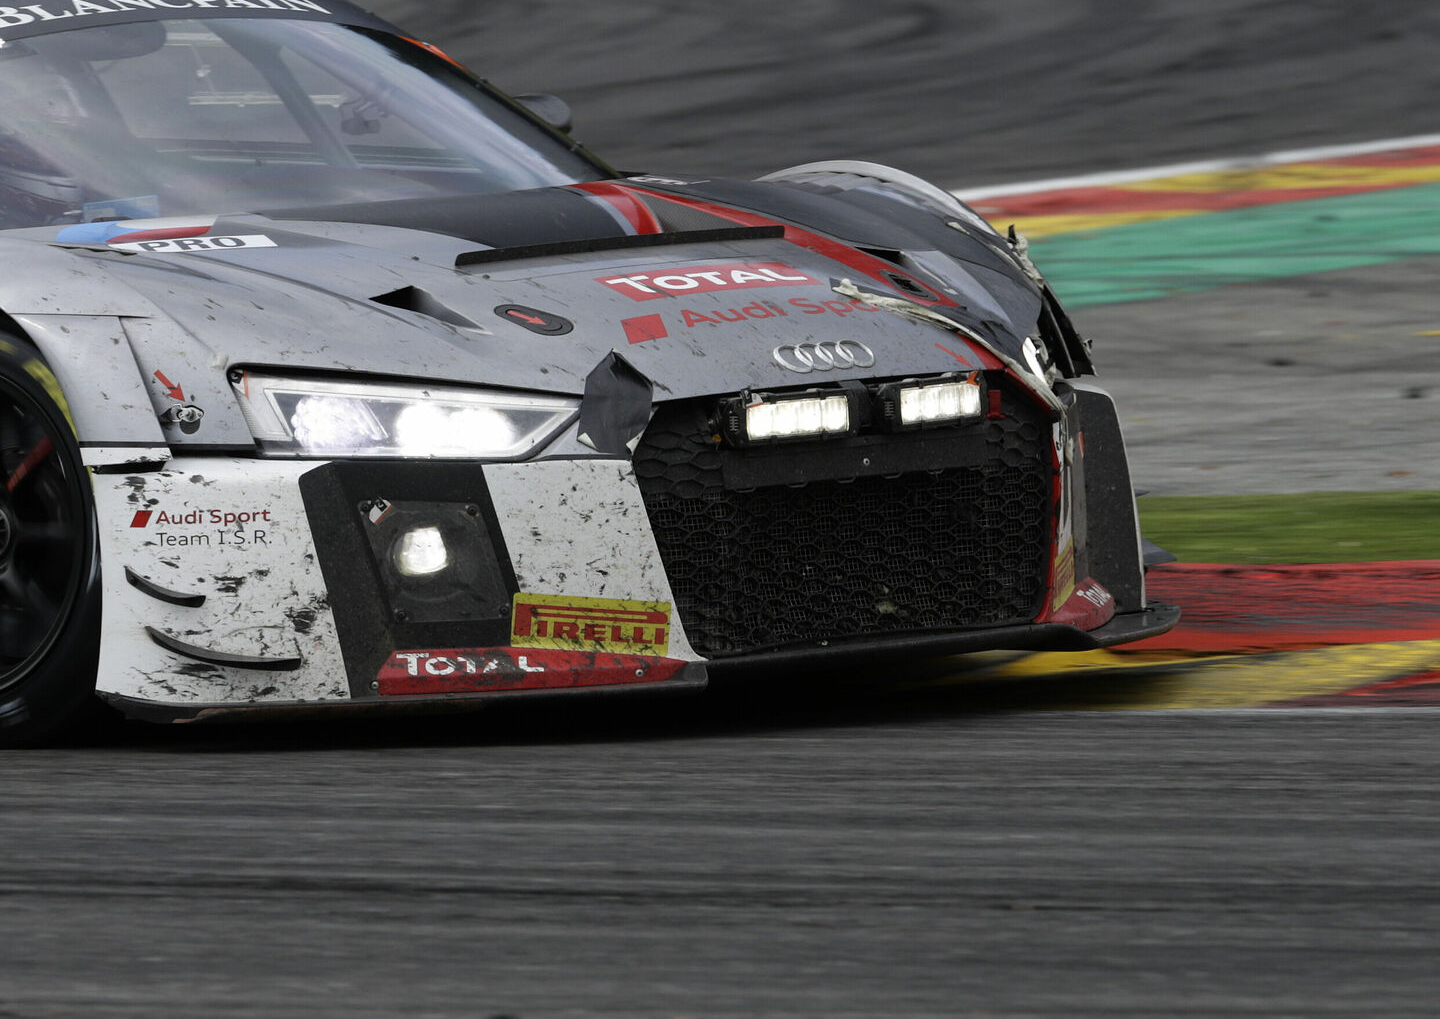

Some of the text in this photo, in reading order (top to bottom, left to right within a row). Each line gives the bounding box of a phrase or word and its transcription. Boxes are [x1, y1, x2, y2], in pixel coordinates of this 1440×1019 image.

[138, 236, 247, 252] PRO
[606, 268, 807, 294] TOTAL
[680, 298, 882, 328] Audi Spo
[155, 508, 272, 527] Audi Sport
[155, 530, 273, 547] Team I.S.R.
[514, 602, 669, 646] PIRELLI
